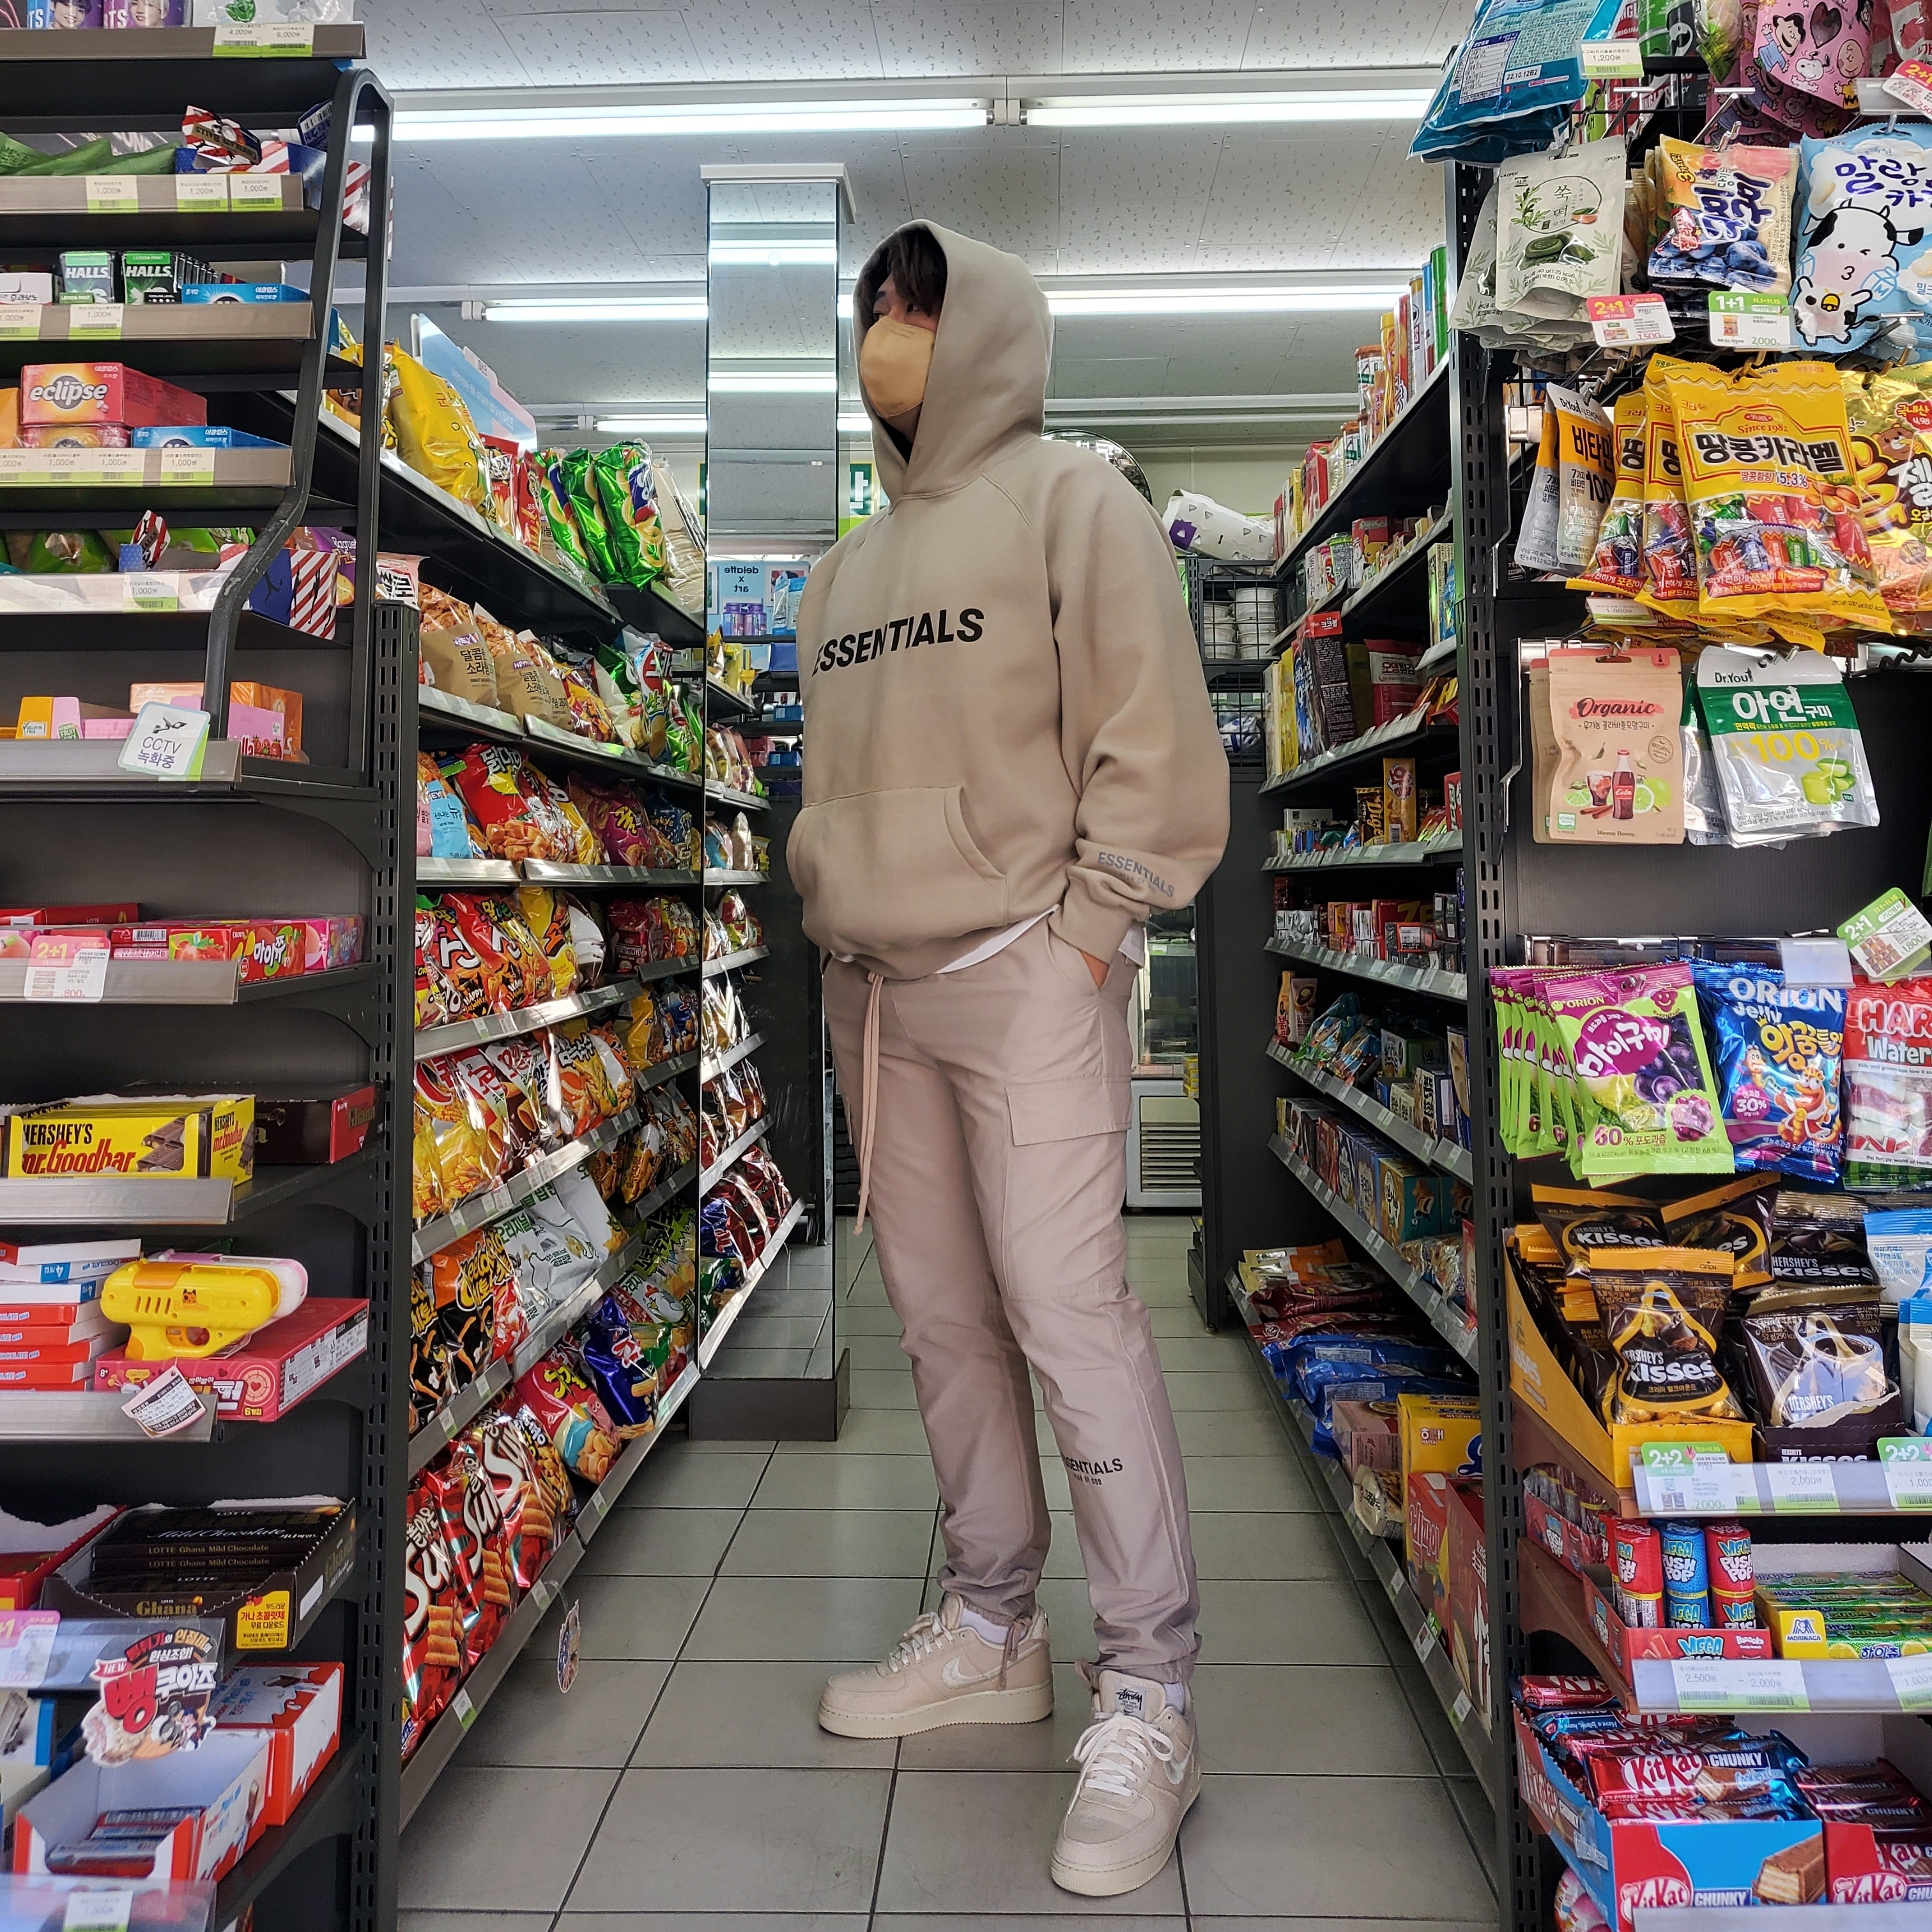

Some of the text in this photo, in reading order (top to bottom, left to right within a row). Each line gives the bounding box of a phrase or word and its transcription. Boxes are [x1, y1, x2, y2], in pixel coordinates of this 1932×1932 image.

[1506, 68, 1538, 80] 22.10.12B2
[1835, 155, 1927, 194] 말랑
[1553, 185, 1572, 202] 쑥
[1731, 172, 1772, 224] 구미
[1553, 204, 1568, 217] 떡
[65, 266, 110, 279] HALLS
[126, 266, 173, 278] HALLS
[1594, 301, 1625, 315] 2+1
[1715, 295, 1745, 312] 1+1
[1751, 337, 1777, 346] 2,000
[29, 381, 108, 406] eclipse
[1896, 403, 1931, 418] 국내산
[1737, 422, 1789, 434] Since 1982
[1571, 425, 1614, 474] 비타민
[1694, 433, 1846, 472] 땅콩카라멜
[1571, 469, 1586, 479] 7가지
[1740, 471, 1809, 488] 땅콩함량 15.3%
[1570, 479, 1586, 488] 비타민
[1596, 573, 1643, 589] 편하게 포장이
[812, 608, 985, 677] ESSENTIALS
[1715, 671, 1750, 684] Dr.You
[1577, 697, 1656, 717] Organic
[1732, 689, 1833, 724] 아연 구미
[1583, 721, 1601, 730] 유기농
[1735, 722, 1756, 731] 면역력
[142, 737, 183, 755] CCTV
[137, 749, 175, 769] 녹화중
[1615, 788, 1632, 797] Cola
[1597, 829, 1616, 838] Weeny
[1098, 851, 1175, 898] ESSENTIALS
[1844, 914, 1873, 940] 2+1
[36, 942, 67, 959] 2+1
[253, 935, 287, 966] 마이쮸
[1901, 935, 1924, 953] 1,800
[1565, 996, 1605, 1009] ORION
[1728, 977, 1843, 1013] ORION
[1733, 1002, 1782, 1023] Jelly
[1577, 1022, 1671, 1077] 마이구미
[1761, 1021, 1843, 1071] 왕꿈틀이
[1882, 1064, 1906, 1073] grown-ups
[1736, 1098, 1768, 1114] 30%
[348, 1103, 376, 1130] Ghana
[22, 1123, 93, 1146] HERSHEY'S
[212, 1122, 244, 1151] mr.Goodbar
[1635, 1133, 1667, 1147] 포도과즙
[22, 1138, 137, 1174] mr.Goodbar
[1662, 1147, 1673, 1155] 9.7
[1681, 1146, 1701, 1154] (고형분
[1876, 1156, 1892, 1164] happy
[1772, 1256, 1818, 1268] HERSHEY'S
[244, 1406, 263, 1416] 6개입
[1788, 1395, 1834, 1411] HERSHEY'S
[1648, 1449, 1685, 1469] 2+2
[1886, 1445, 1919, 1462] 2+2
[1790, 1475, 1822, 1486] 2,000원
[1663, 1538, 1694, 1558] MEGA
[1718, 1537, 1751, 1557] MEGA
[1662, 1554, 1696, 1573] PUSH
[1720, 1554, 1754, 1573] PUSH
[1665, 1565, 1695, 1583] POP
[1726, 1567, 1754, 1583] POP
[136, 1601, 198, 1616] Ghana
[240, 1612, 256, 1621] 가나
[1669, 1601, 1701, 1623] MEGA
[1678, 1635, 1724, 1657] MEGA
[1736, 1636, 1765, 1646] Bazooka
[149, 1647, 193, 1662] 환상조합!
[1860, 1644, 1901, 1659] 하이츄
[103, 1661, 128, 1675] NEW
[1685, 1673, 1717, 1684] 2,500원
[1750, 1678, 1782, 1689] 2,000원
[1630, 1752, 1763, 1797] KitKat CHUNKY
[1694, 1891, 1747, 1906] CHUNKY
